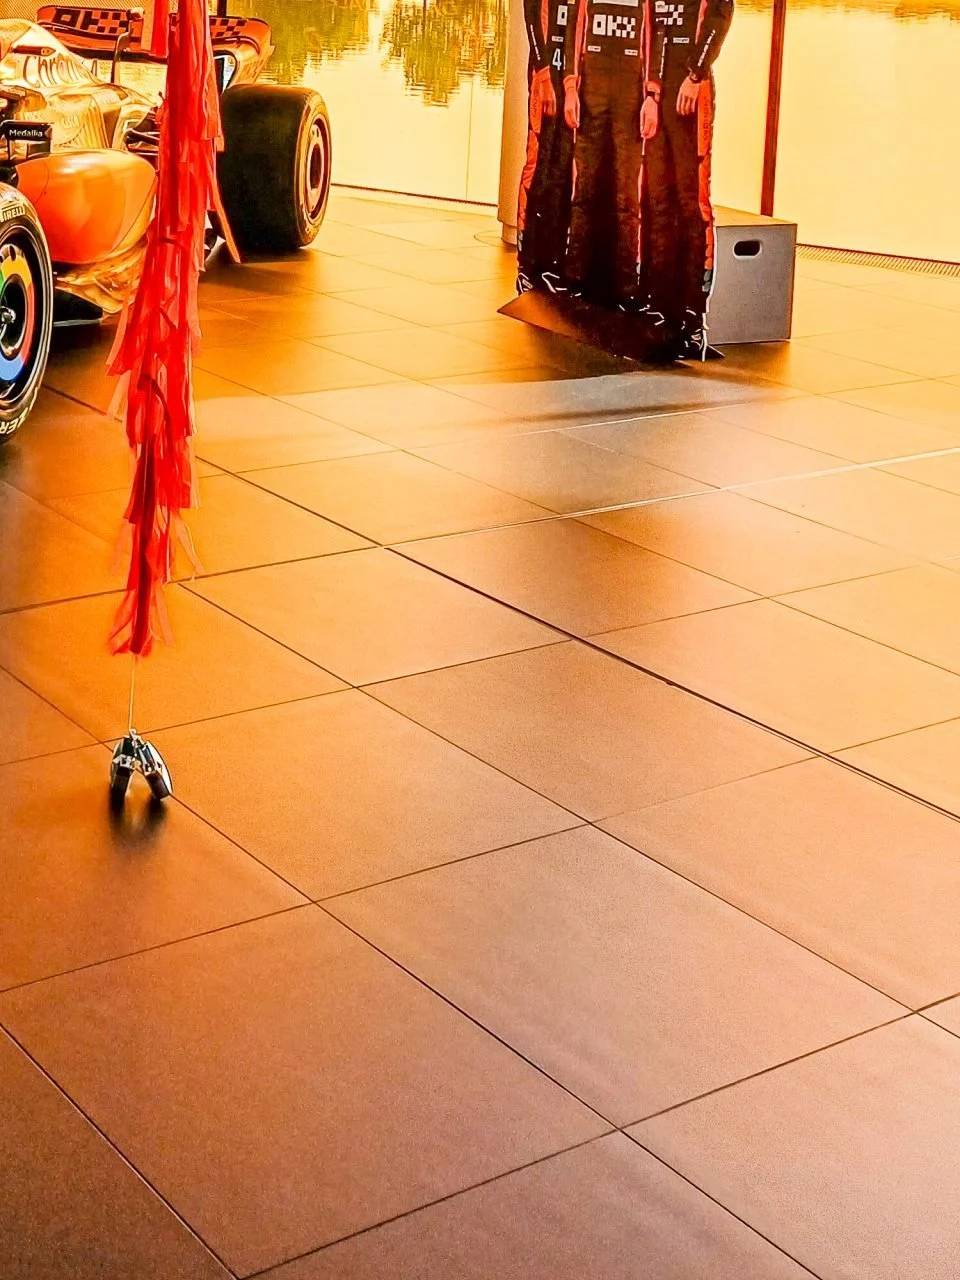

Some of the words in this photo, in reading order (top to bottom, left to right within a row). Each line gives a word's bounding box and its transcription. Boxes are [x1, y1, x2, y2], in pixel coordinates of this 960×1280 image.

[592, 14, 636, 39] OKX
[552, 48, 562, 71] 4
[9, 129, 43, 138] Medallia
